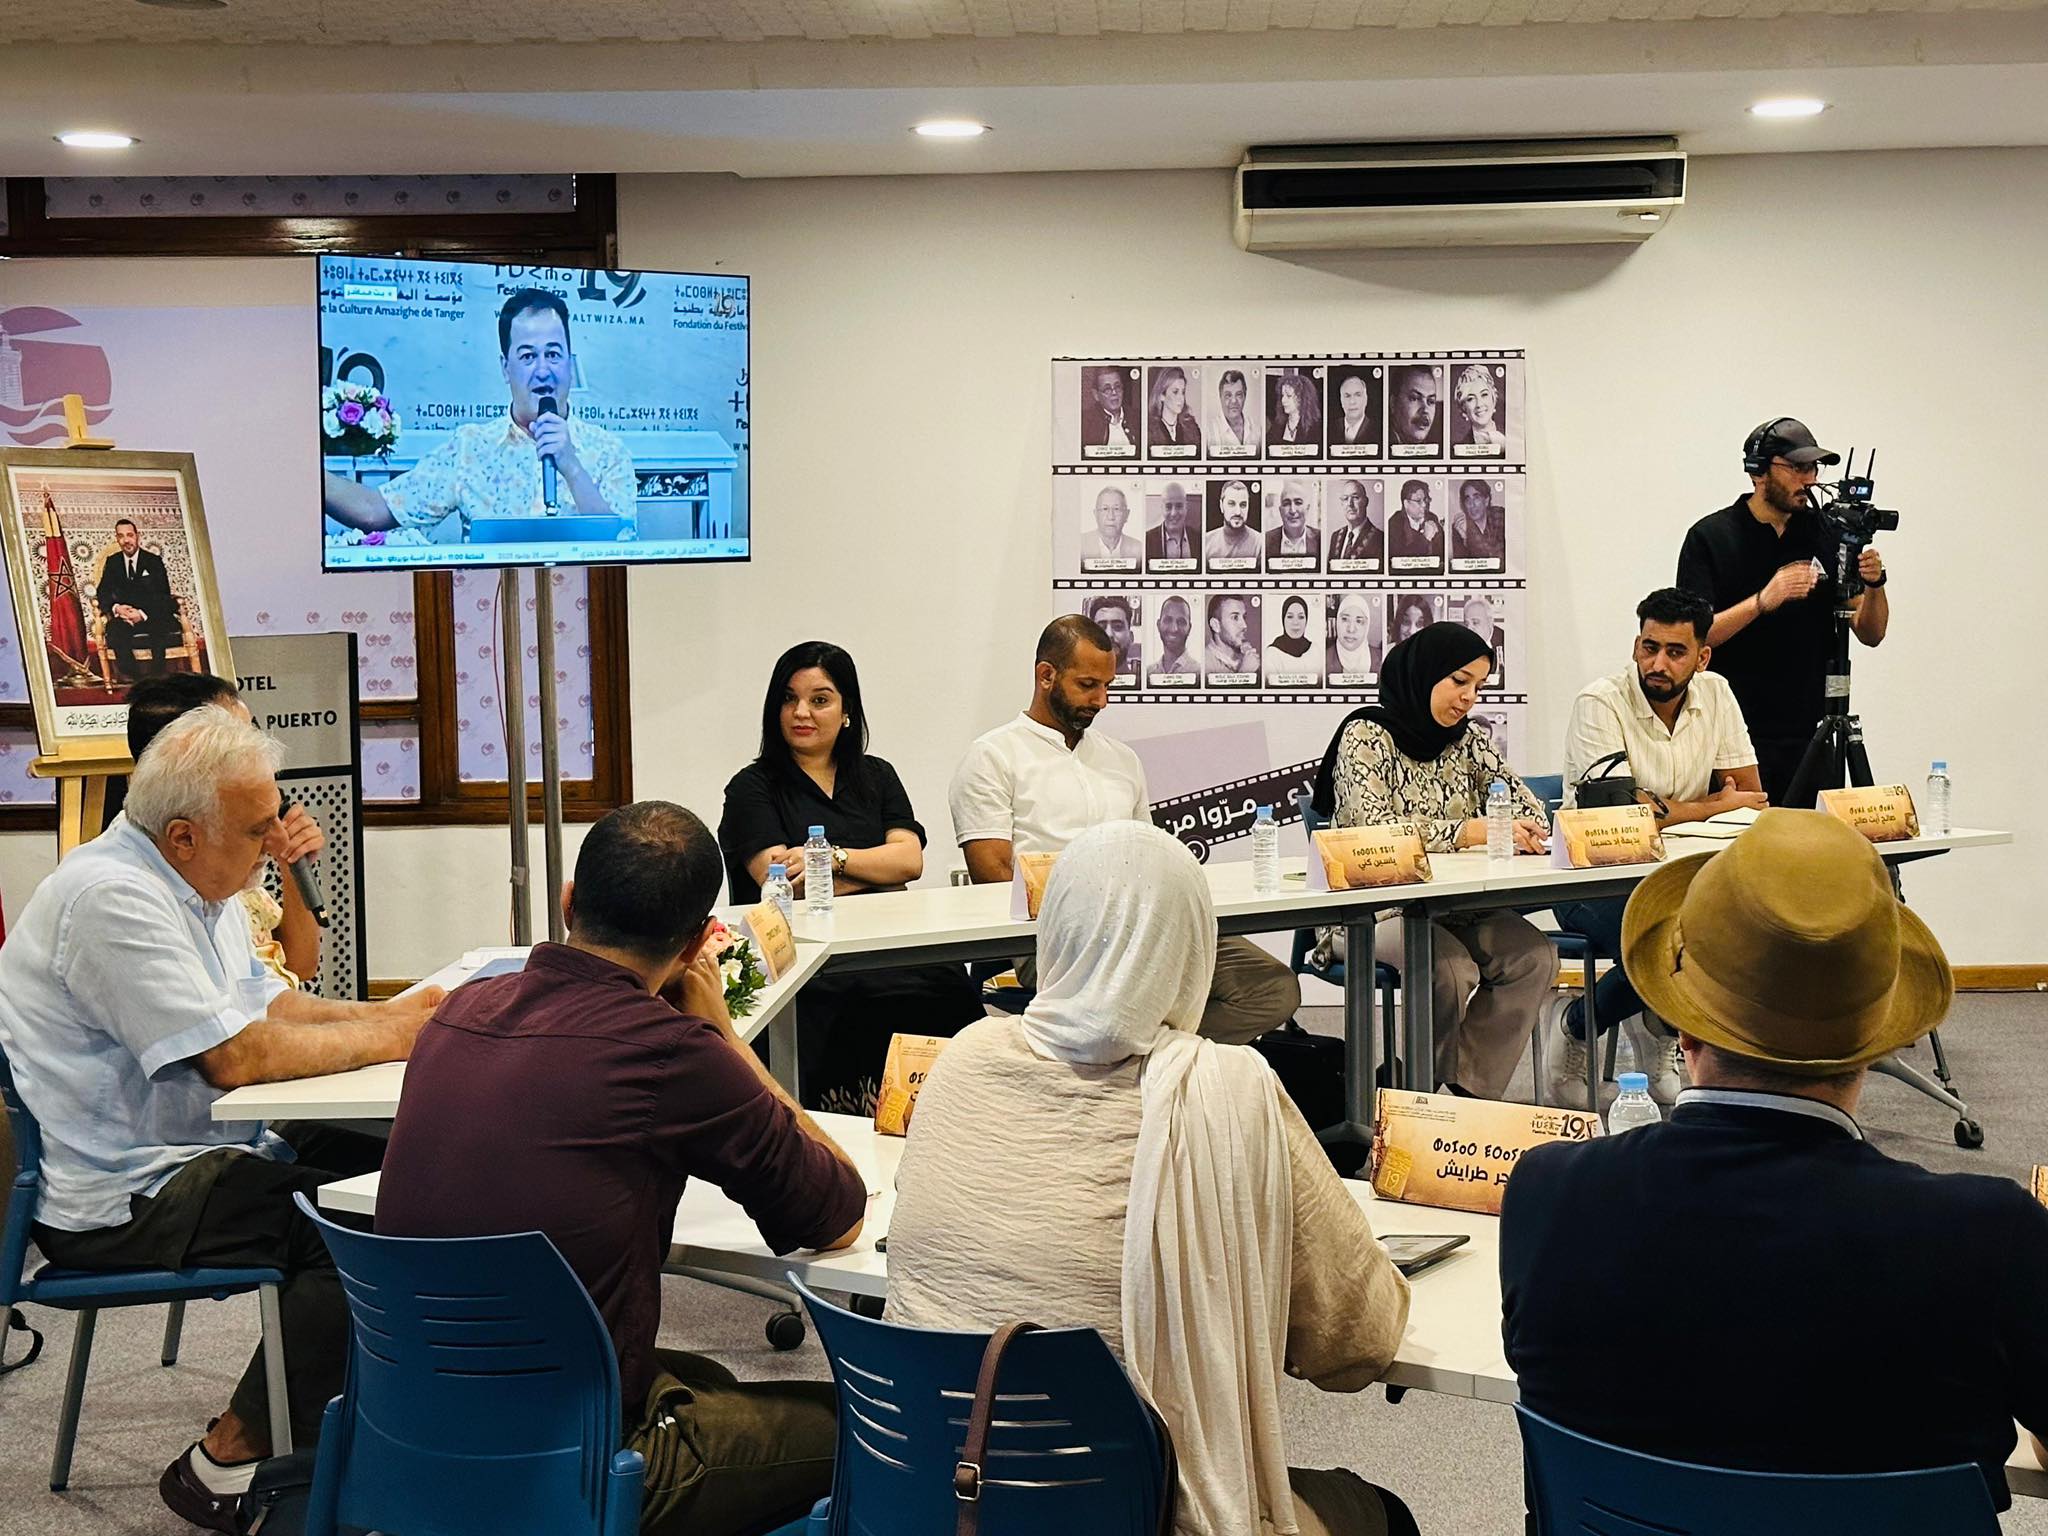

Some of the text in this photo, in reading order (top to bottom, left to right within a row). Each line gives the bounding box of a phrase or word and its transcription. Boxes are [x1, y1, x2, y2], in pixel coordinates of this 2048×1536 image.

[329, 302, 339, 314] la
[339, 303, 373, 315] Culture
[375, 305, 420, 320] Amazighe
[421, 307, 433, 318] de
[435, 308, 465, 322] Tanger
[673, 319, 712, 330] Fondation
[713, 320, 724, 330] du
[266, 710, 338, 730] PUERTO
[1560, 1113, 1586, 1141] 19
[1484, 1143, 1527, 1162] ⵟⵔⴰⵢ
[1435, 1158, 1489, 1182] طرايش
